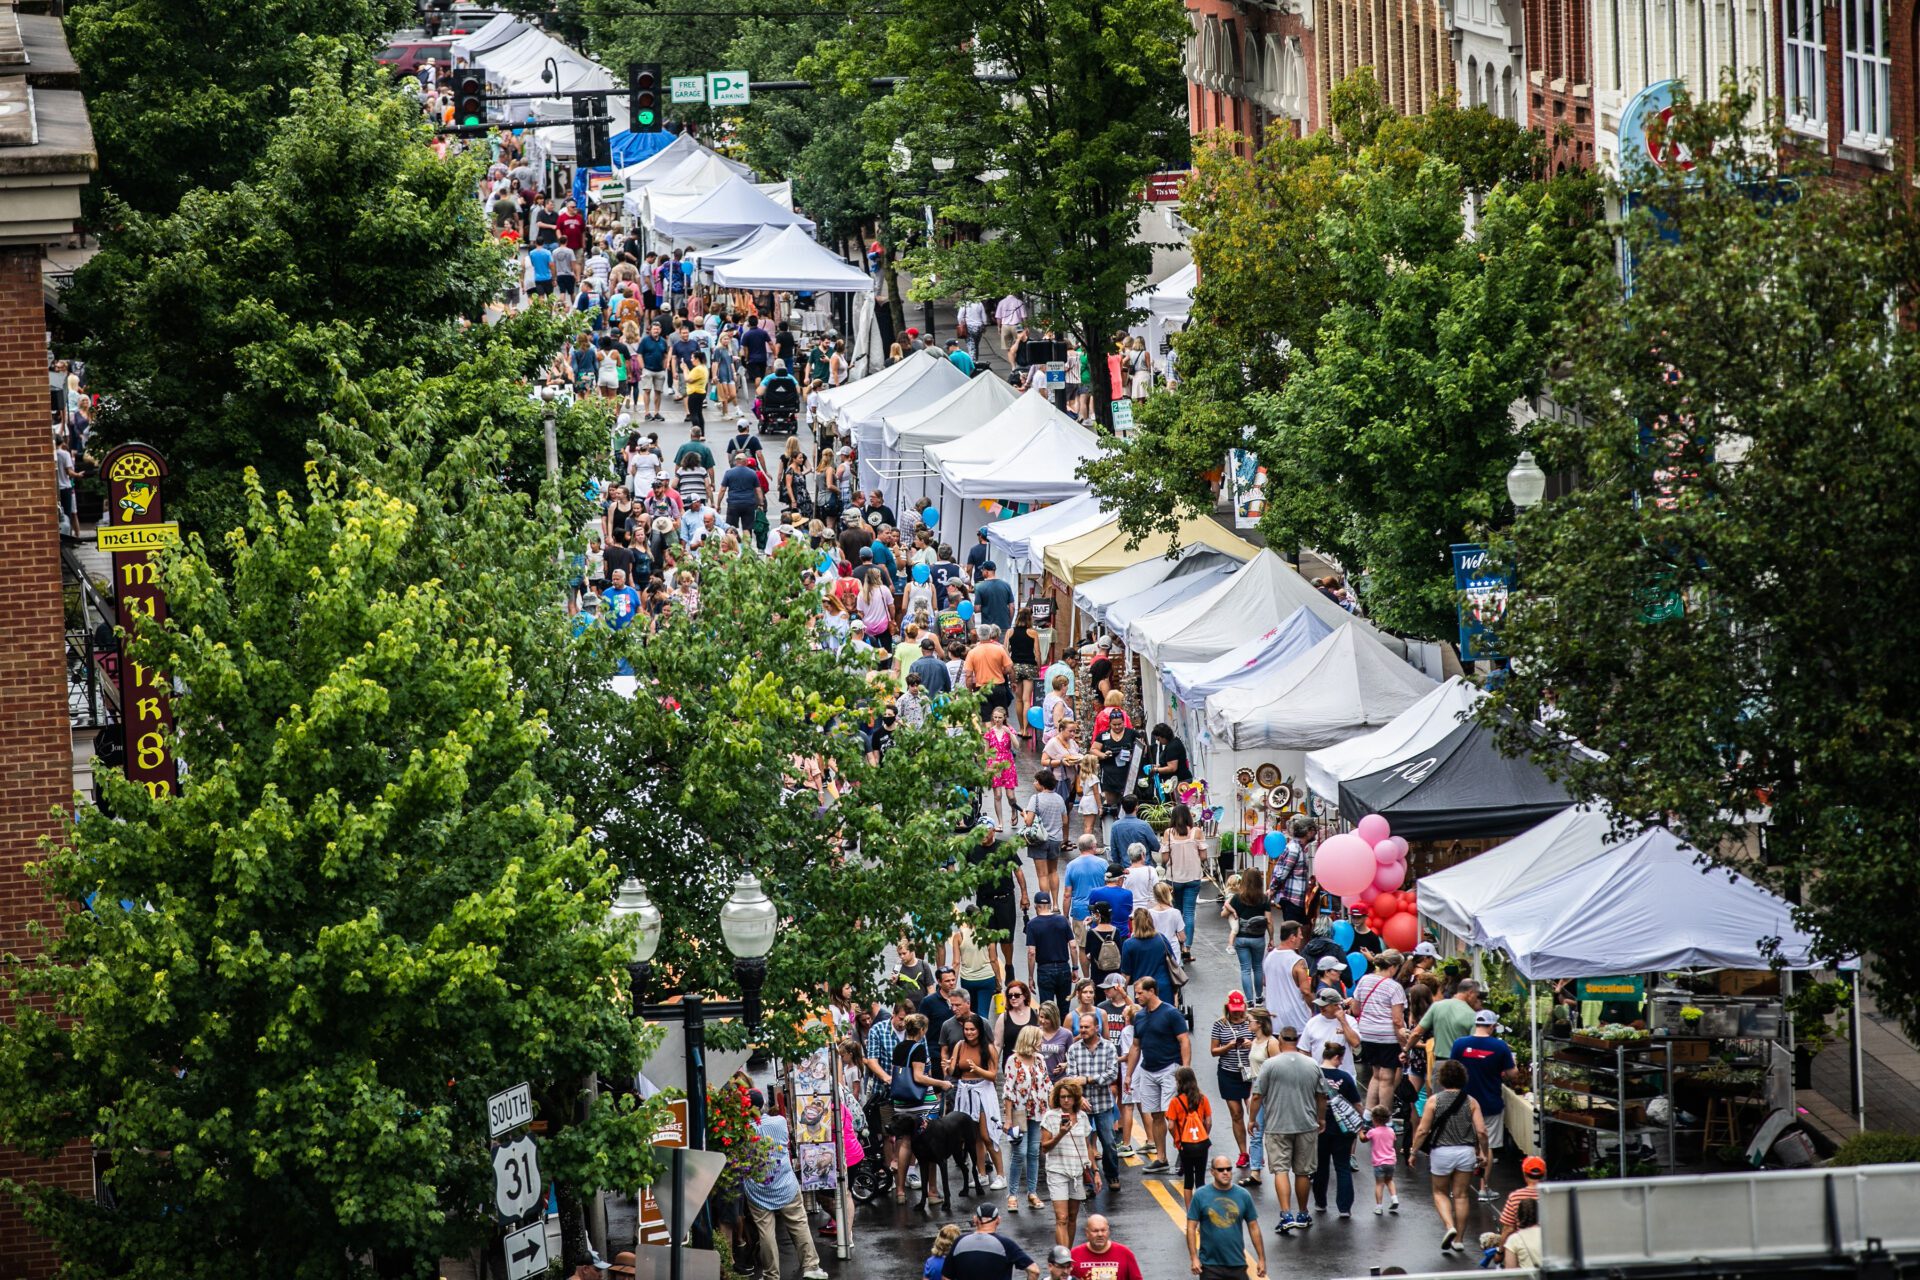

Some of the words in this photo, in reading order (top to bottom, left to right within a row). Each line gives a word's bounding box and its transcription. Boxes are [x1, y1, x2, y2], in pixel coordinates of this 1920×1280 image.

[103, 531, 174, 545] mello
[937, 568, 948, 584] 3
[1585, 983, 1635, 994] Succulents
[1107, 1014, 1125, 1022] ESUS.
[492, 1092, 528, 1126] SOUTH
[1190, 1126, 1199, 1140] T
[504, 1152, 532, 1200] 31
